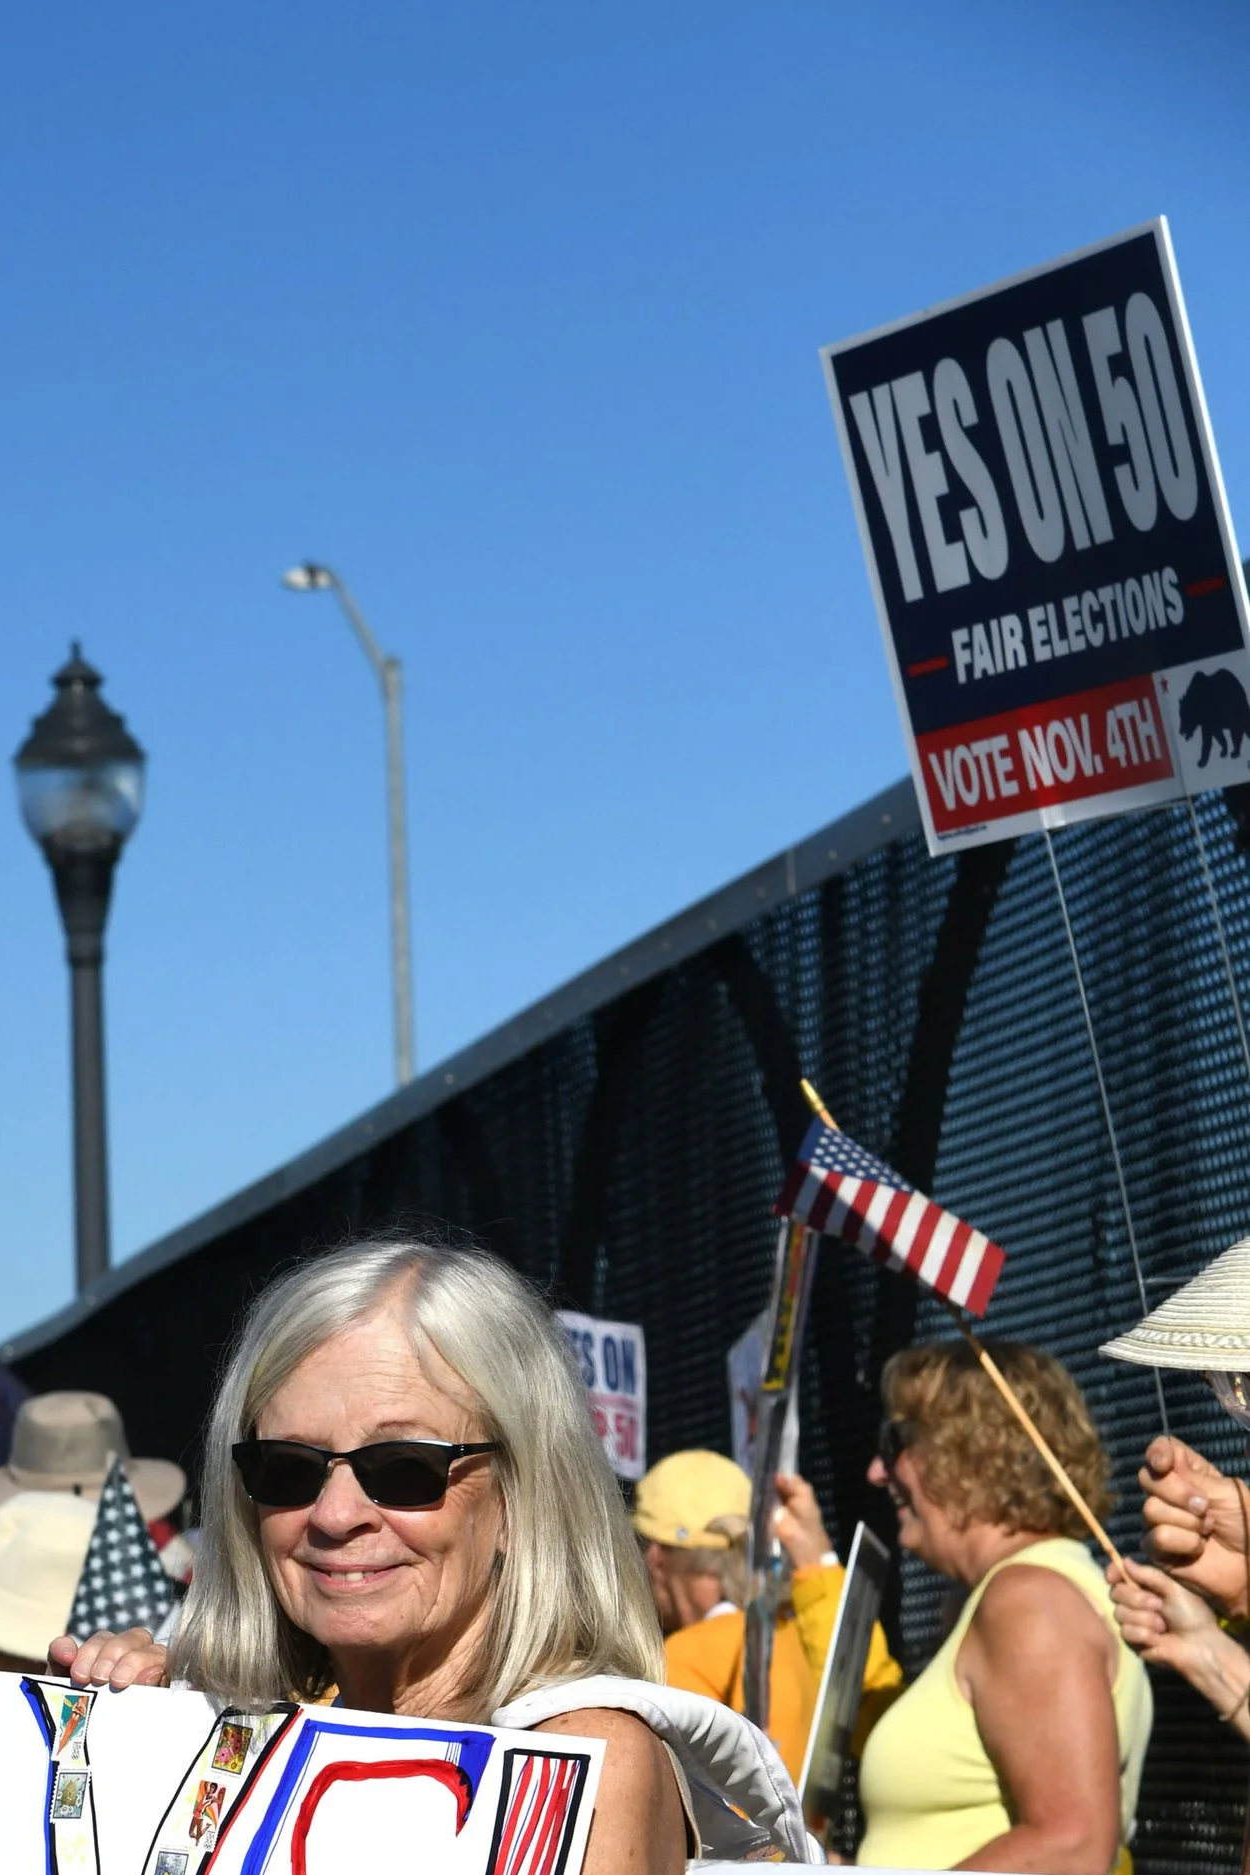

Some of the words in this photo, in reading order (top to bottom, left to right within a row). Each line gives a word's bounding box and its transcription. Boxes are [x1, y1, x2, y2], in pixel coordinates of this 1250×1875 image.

[848, 356, 1010, 604] YES
[985, 318, 1115, 564] ON
[1080, 291, 1199, 533] 50
[950, 613, 1028, 685] FAIR
[1026, 565, 1185, 664] ELECTIONS
[928, 734, 1020, 812] VOTE
[1017, 713, 1105, 792] NOV.
[1105, 696, 1163, 769] 4TH
[602, 1333, 636, 1396] ON
